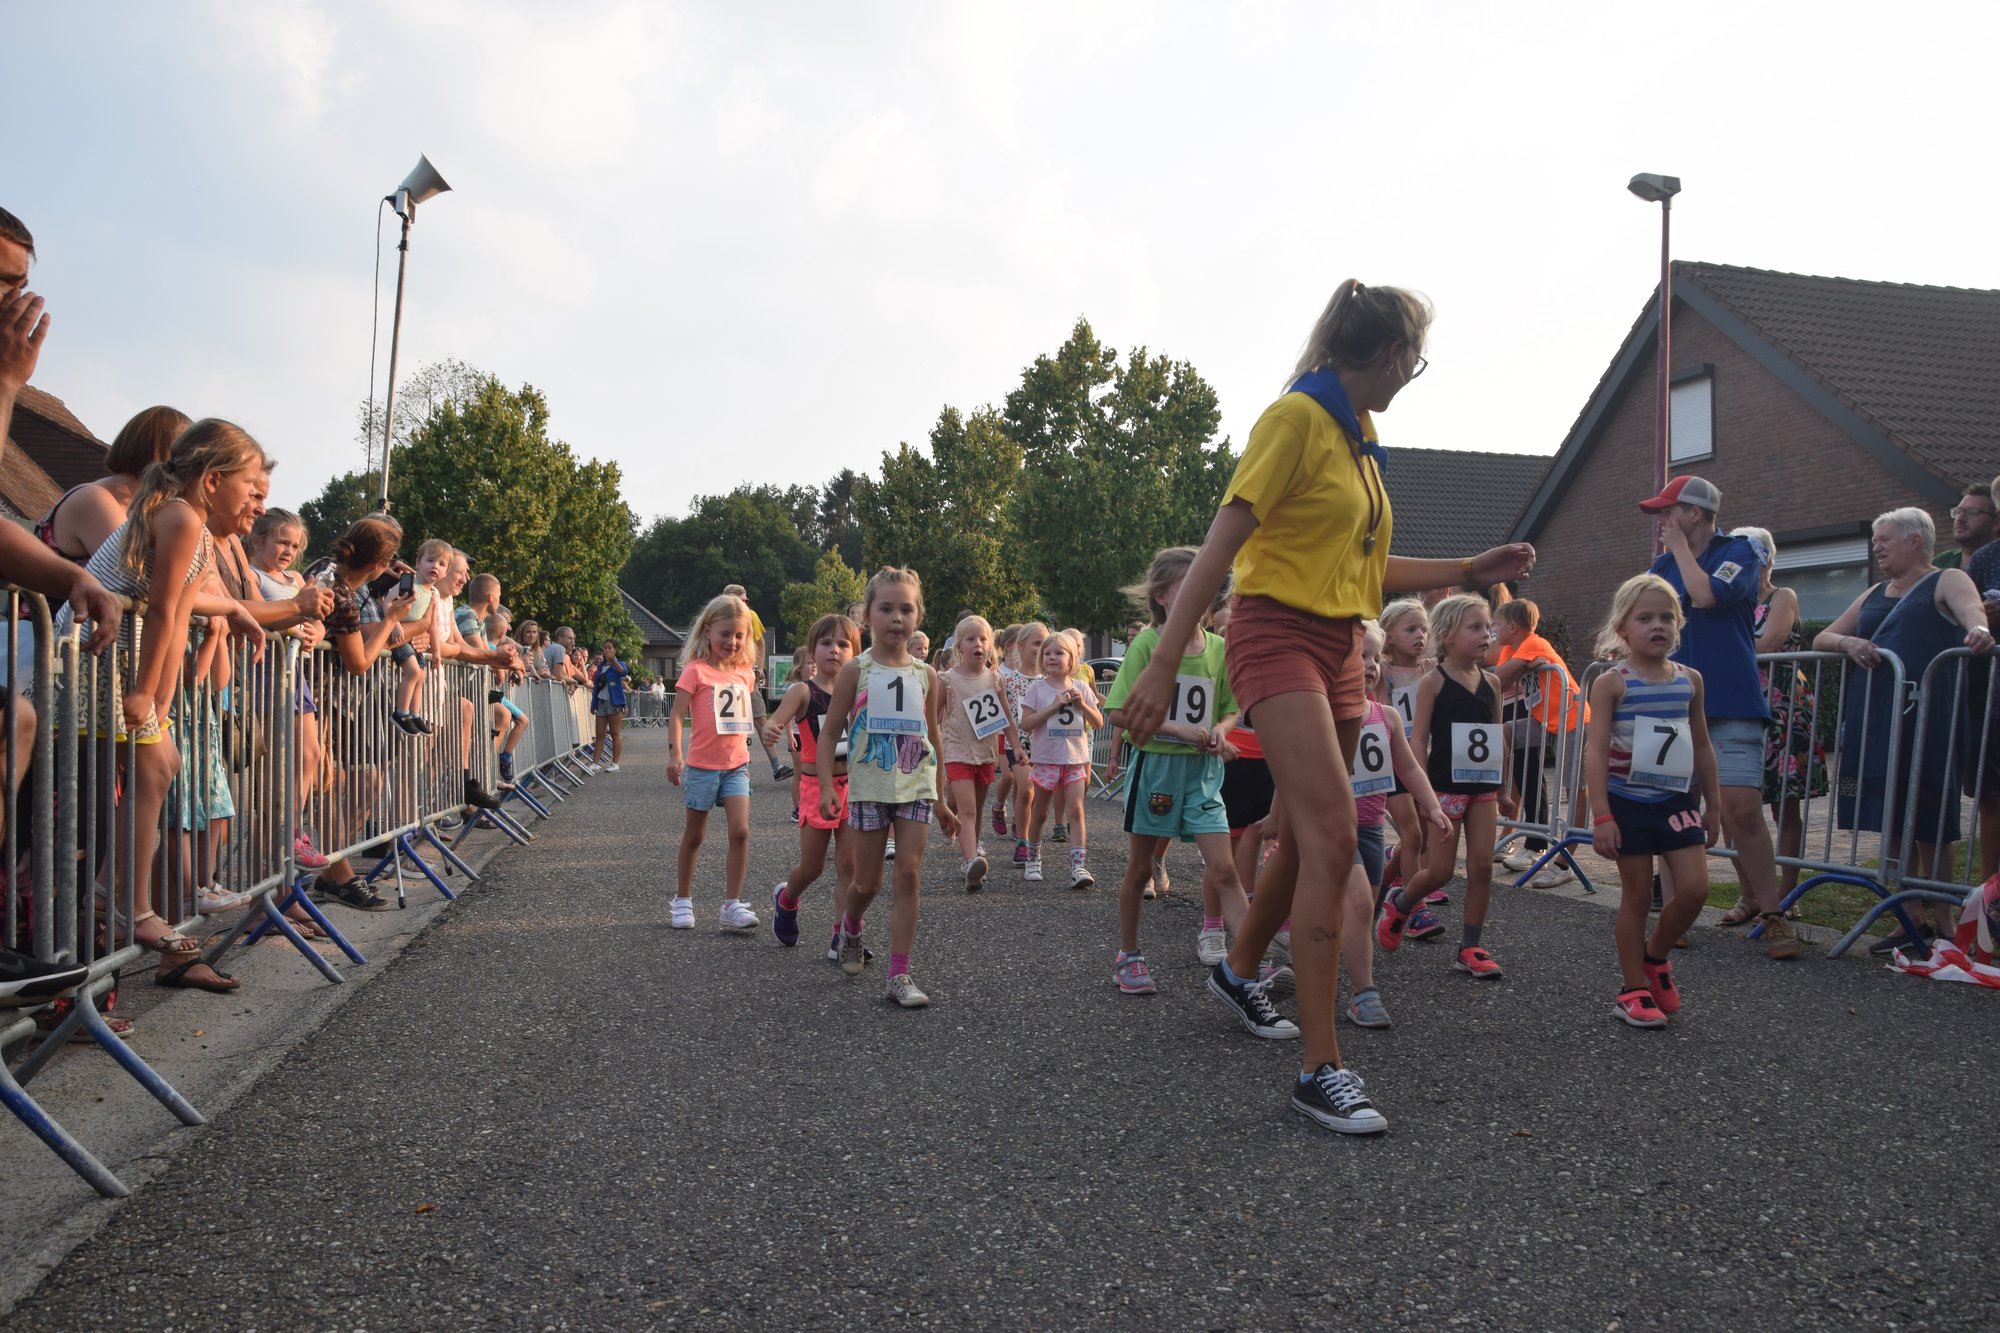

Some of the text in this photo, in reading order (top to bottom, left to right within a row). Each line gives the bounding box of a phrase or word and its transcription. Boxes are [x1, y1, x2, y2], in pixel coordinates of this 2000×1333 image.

[719, 689, 747, 718] 21
[887, 676, 903, 712] 1
[969, 694, 999, 724] 23
[1169, 682, 1206, 724] 19
[1058, 702, 1074, 726] 5
[1351, 733, 1384, 775] 6
[1468, 728, 1489, 763] 8
[1653, 725, 1678, 766] 7
